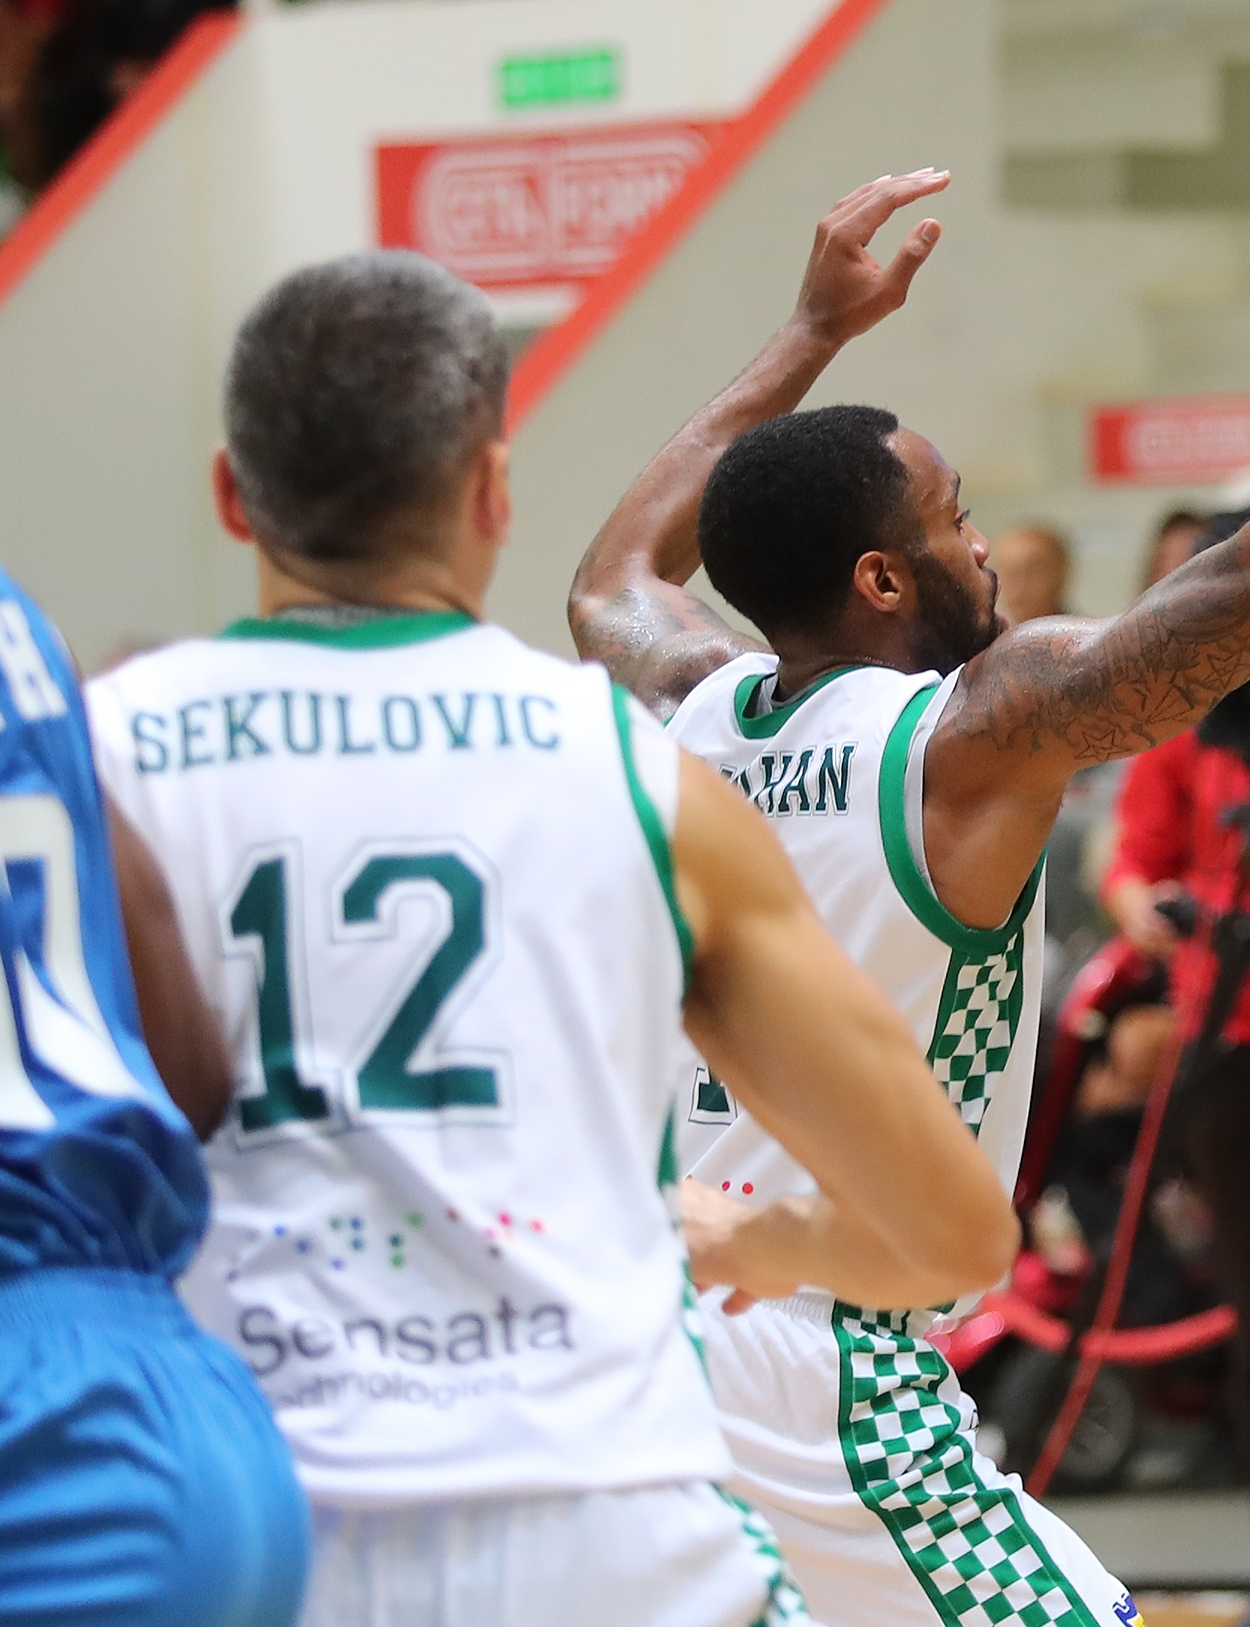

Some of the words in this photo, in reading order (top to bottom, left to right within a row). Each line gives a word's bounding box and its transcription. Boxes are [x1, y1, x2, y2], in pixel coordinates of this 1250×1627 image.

[131, 690, 562, 775] SEKULOVIC
[224, 842, 510, 1134] 12
[238, 1297, 573, 1377] Sensata
